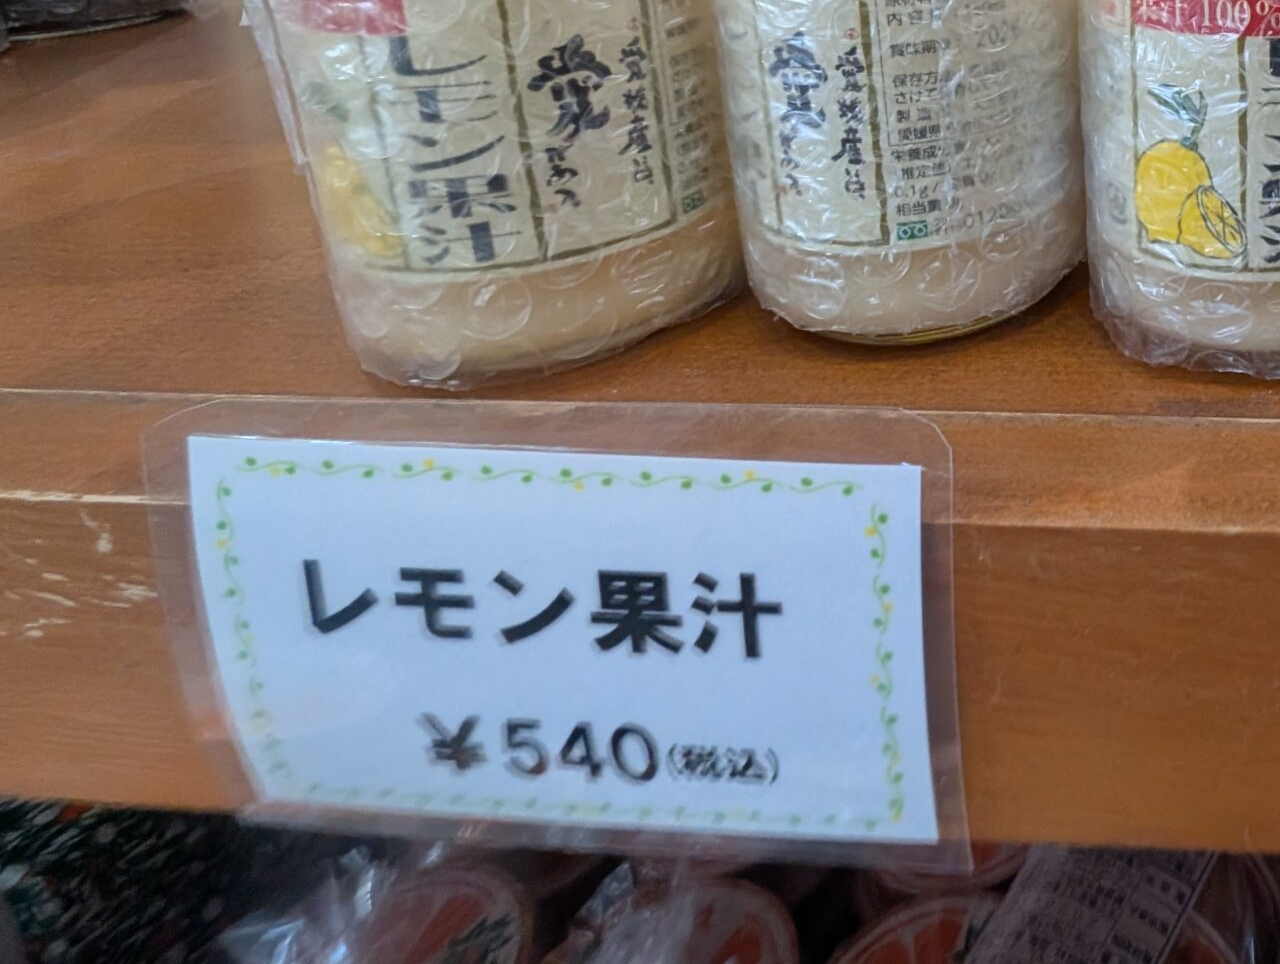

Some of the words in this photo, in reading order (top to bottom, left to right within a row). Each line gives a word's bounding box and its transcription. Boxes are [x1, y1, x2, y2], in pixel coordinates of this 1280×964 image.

[302, 559, 783, 658] レモン果汁
